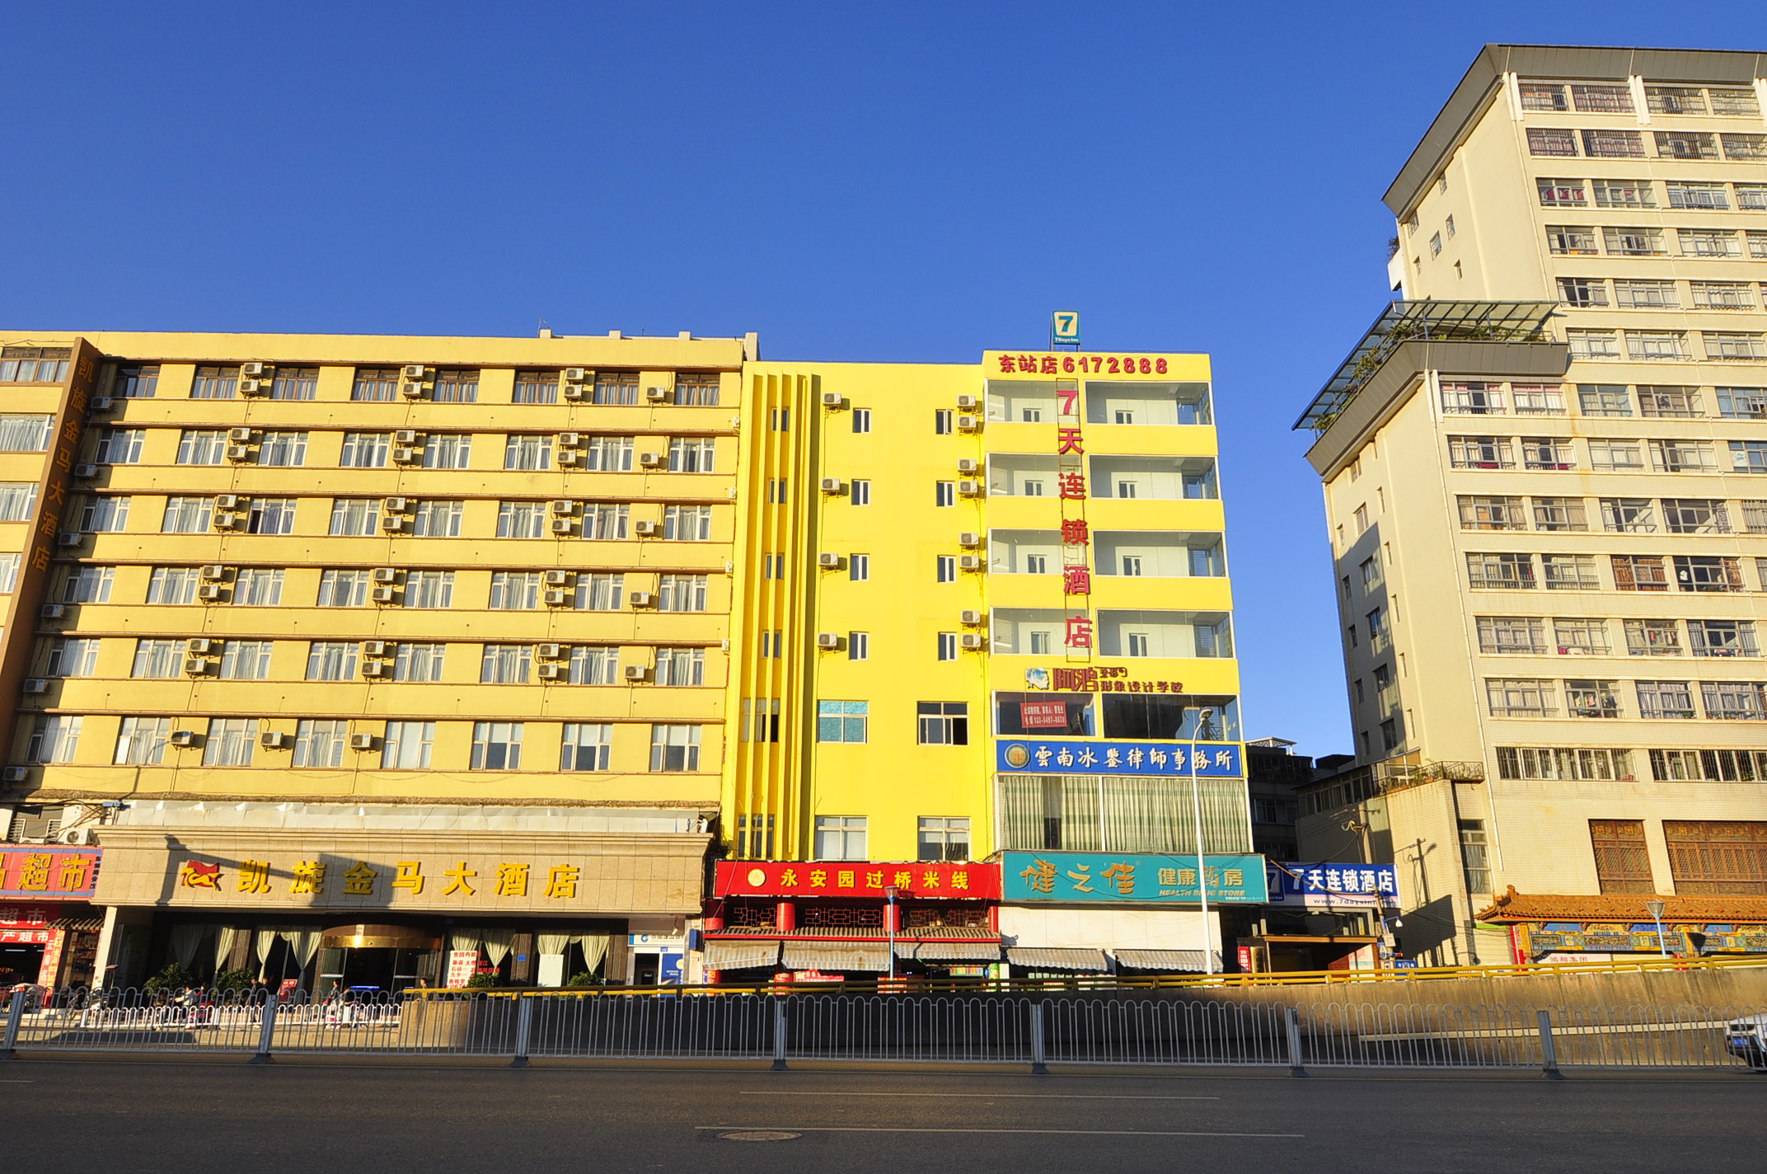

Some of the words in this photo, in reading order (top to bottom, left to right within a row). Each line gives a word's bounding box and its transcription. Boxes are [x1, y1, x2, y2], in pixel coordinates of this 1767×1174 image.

[1058, 315, 1074, 332] 7
[32, 355, 95, 572] 凯旋金马大酒店
[1056, 390, 1093, 649] 7天连锁酒店
[1100, 681, 1184, 693] 形象设计学校
[0, 853, 91, 892] 超市
[237, 859, 580, 898] 凯旋金马大酒店
[780, 868, 969, 890] 永安园过桥米线
[1019, 859, 1136, 894] 健之佳
[1158, 865, 1244, 888] 健康药房
[1289, 868, 1394, 893] 7天连锁酒店
[1159, 889, 1192, 897] HEALTH
